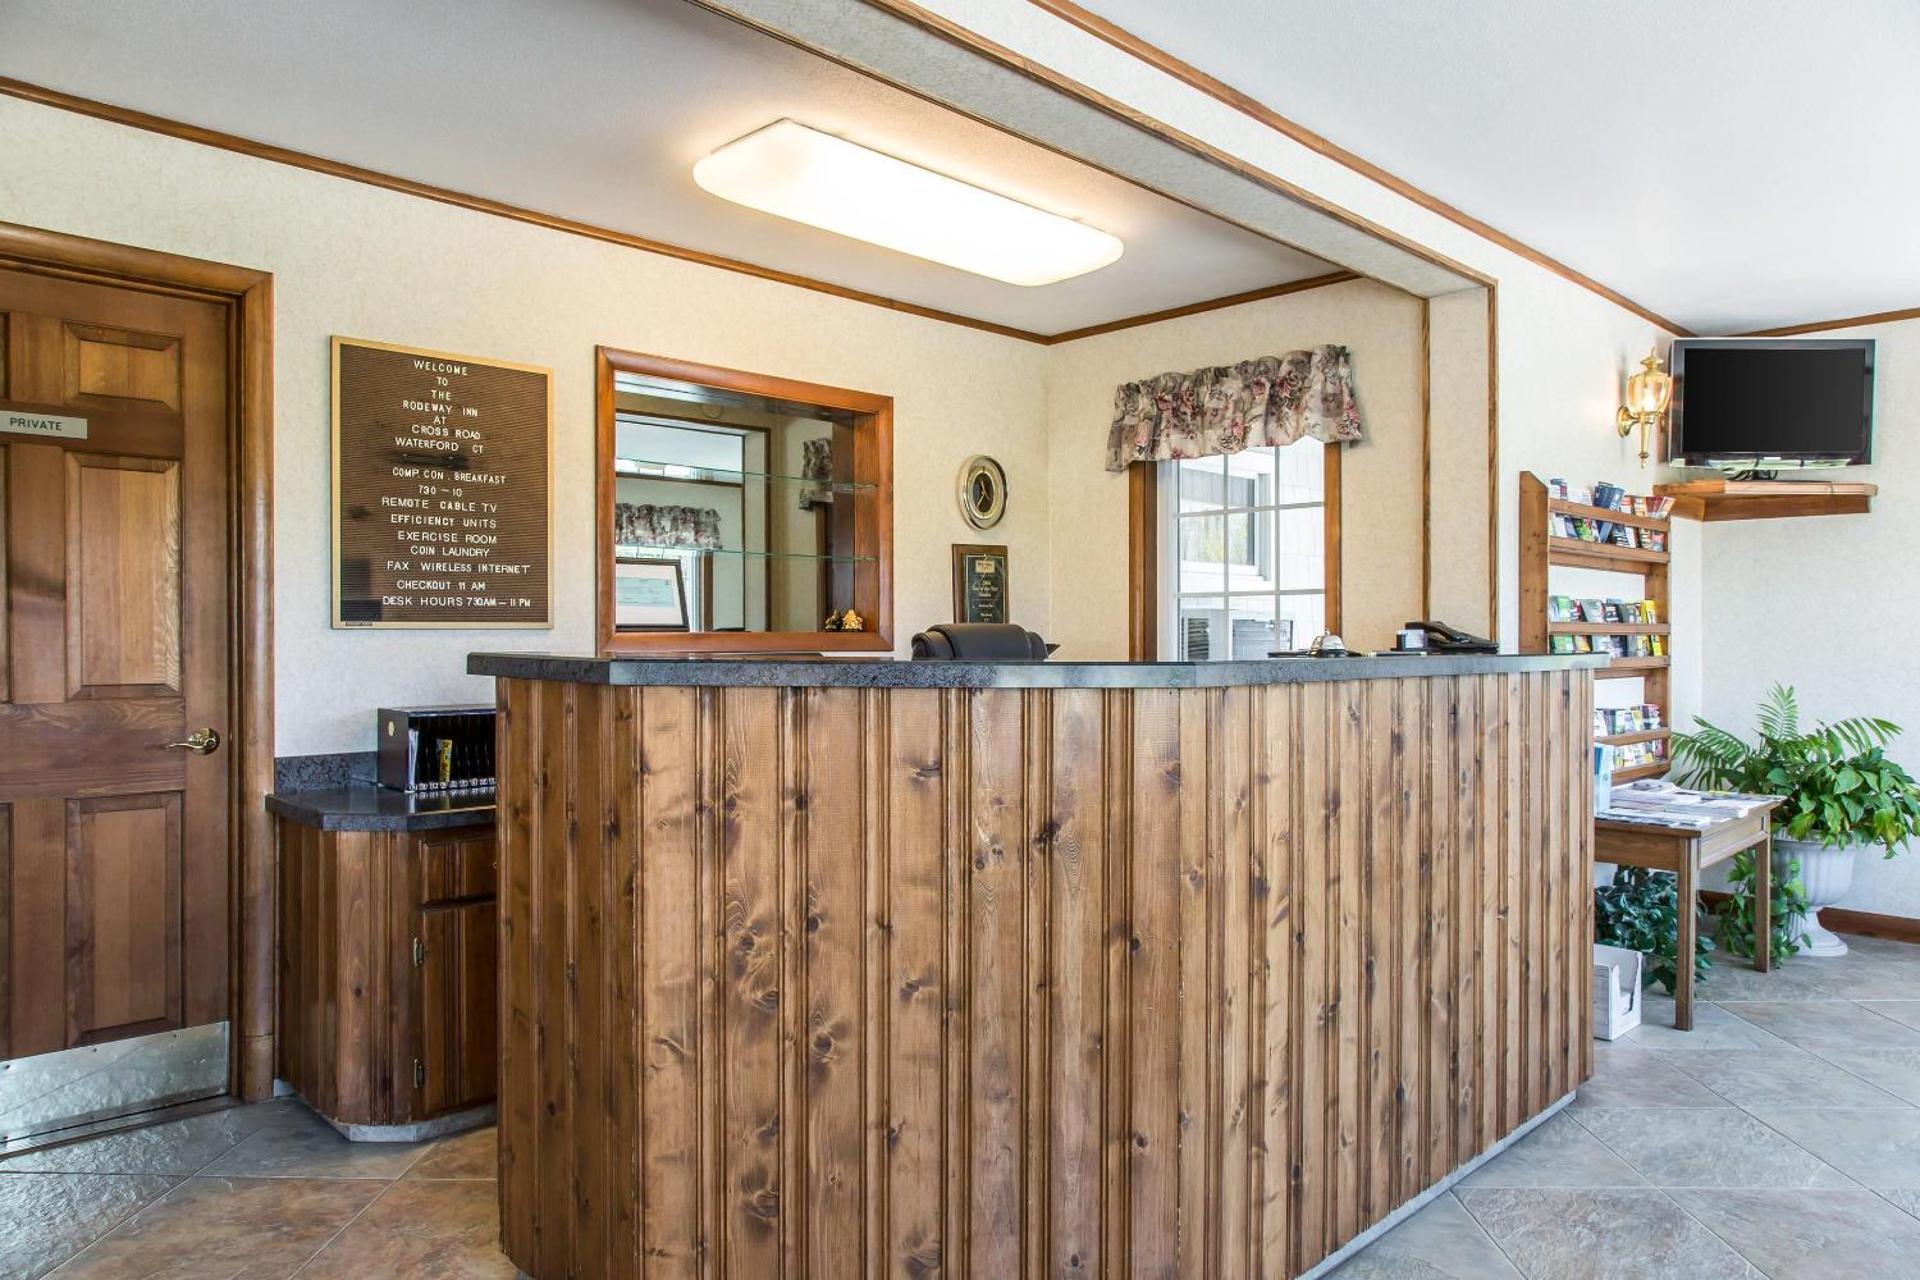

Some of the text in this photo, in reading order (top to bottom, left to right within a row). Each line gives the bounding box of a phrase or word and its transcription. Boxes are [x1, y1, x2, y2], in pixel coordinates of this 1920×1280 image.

[414, 360, 468, 375] WELCOME
[436, 376, 448, 386] TO
[431, 390, 452, 400] THE
[402, 400, 478, 417] RODEWAY INN
[10, 416, 62, 430] PRIVATE
[434, 416, 447, 425] AT
[412, 425, 448, 436] CROSS
[394, 437, 484, 454] WATERFORD CT
[454, 472, 506, 484] BREAKFAST
[452, 488, 463, 498] 10
[382, 497, 498, 513] REMOTE CABLE TV
[391, 514, 497, 529] EFFICIENCY UNITS
[398, 531, 497, 544] EXERCISE ROOM
[410, 545, 490, 558] COIN LAUNDRY
[387, 560, 531, 574] FAX WIRELESS INTERNET
[396, 580, 451, 590] CHECKOUT
[470, 582, 486, 591] AM
[382, 596, 412, 606] DESK
[420, 597, 463, 606] HOURS
[518, 598, 531, 607] PM
